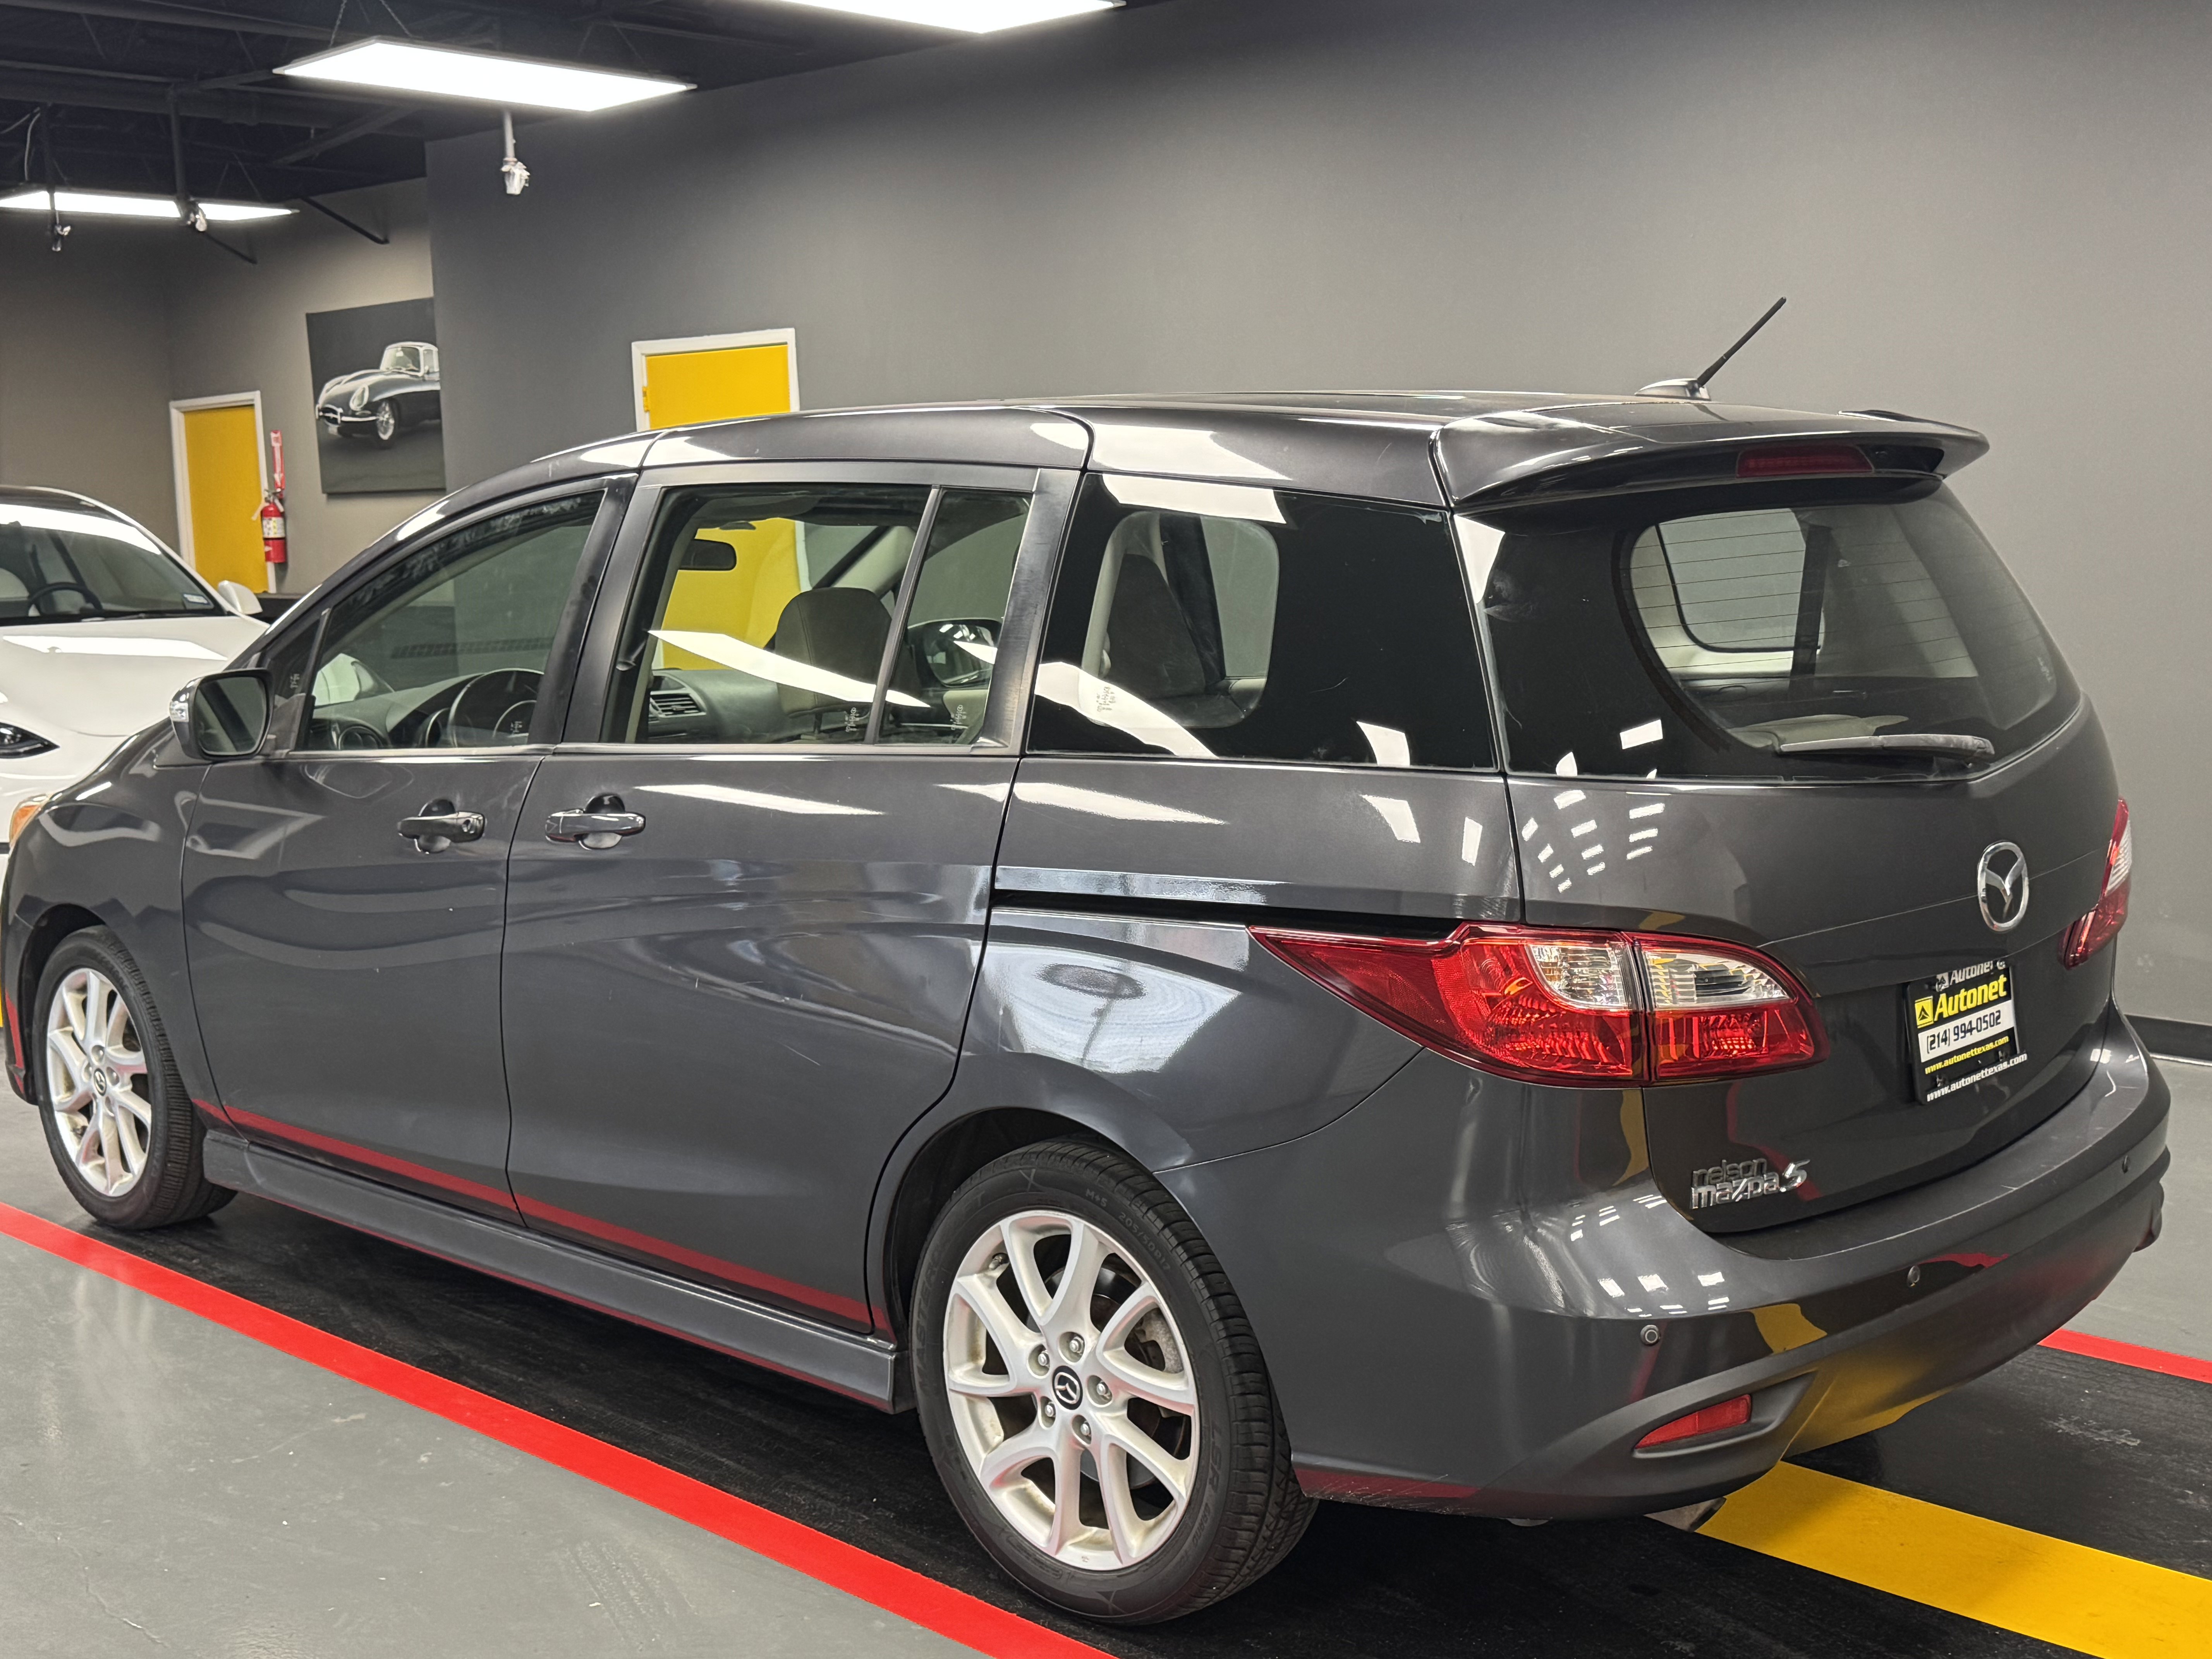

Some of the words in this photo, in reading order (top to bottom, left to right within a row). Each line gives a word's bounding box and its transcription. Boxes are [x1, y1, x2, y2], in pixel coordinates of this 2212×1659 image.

[1950, 960, 1993, 986] Autonet
[1934, 974, 2007, 1021] Autonet
[1927, 1027, 1950, 1054] (214)
[1953, 1010, 2001, 1042] 994-0502
[1925, 1036, 2009, 1075] www.autonettexas.com
[1927, 1053, 2028, 1102] www.autonettexas.com
[1693, 1158, 1767, 1187] nelson
